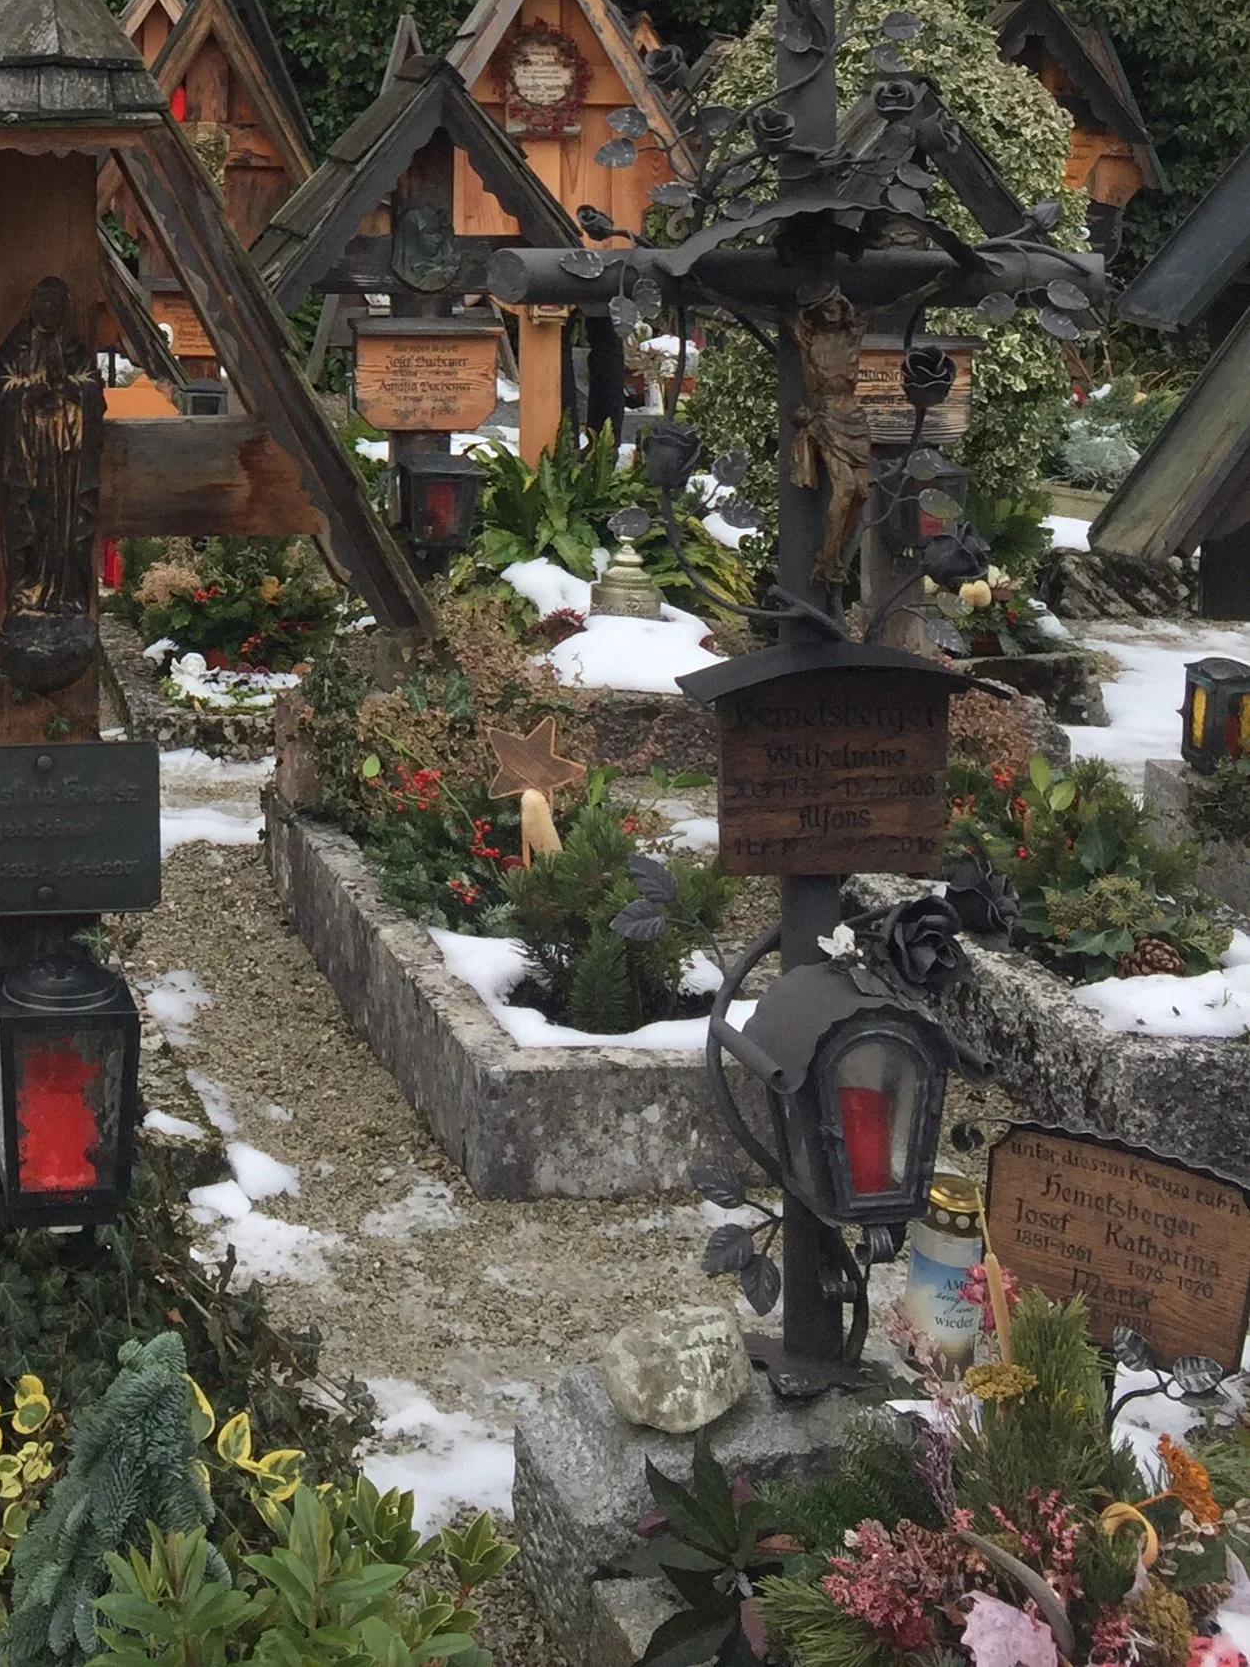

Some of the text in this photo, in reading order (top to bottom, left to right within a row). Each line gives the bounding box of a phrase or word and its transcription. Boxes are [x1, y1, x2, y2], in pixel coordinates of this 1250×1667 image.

[1014, 1198, 1222, 1278] Josef Katharina
[1041, 1172, 1201, 1240] Hemetsberger
